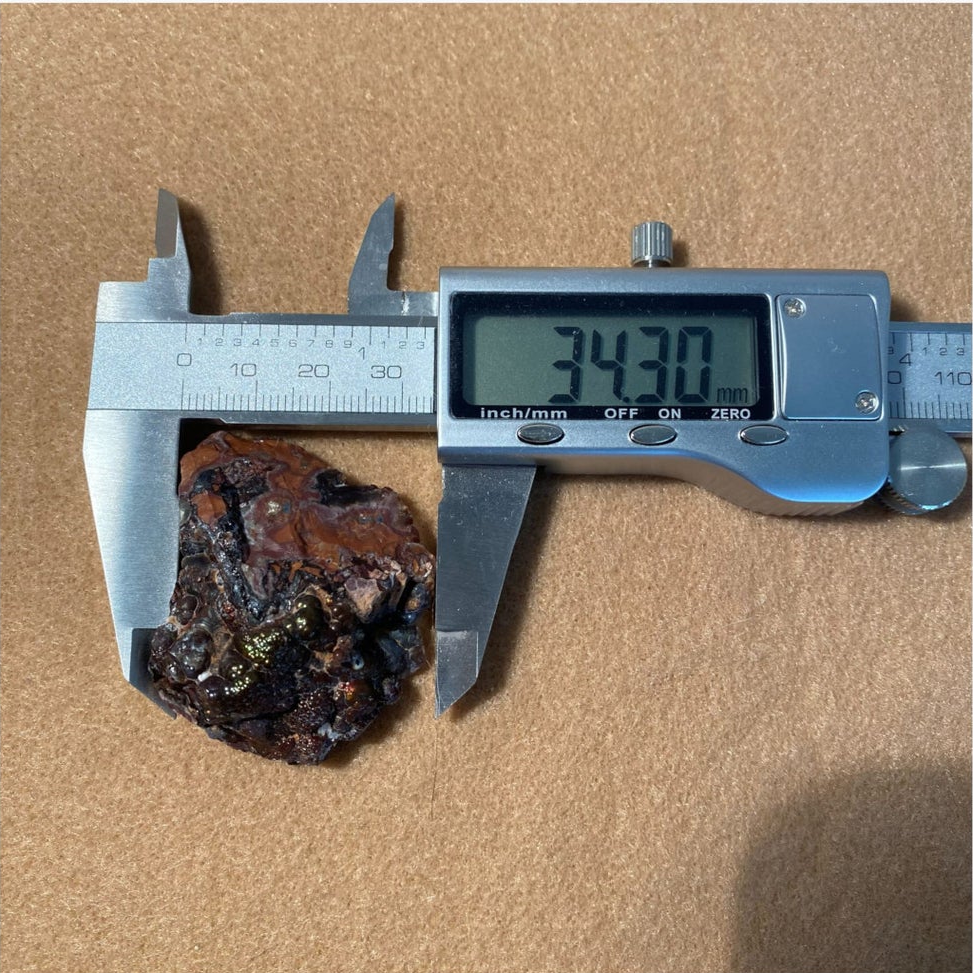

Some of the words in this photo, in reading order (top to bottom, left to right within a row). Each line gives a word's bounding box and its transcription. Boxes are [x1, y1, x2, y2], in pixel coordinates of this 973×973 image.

[176, 352, 192, 367] 0
[229, 362, 257, 377] 10
[297, 363, 330, 378] 20
[370, 364, 403, 379] 30
[548, 326, 712, 404] 34.30
[934, 371, 972, 386] 110
[480, 407, 568, 420] inch/mm
[604, 408, 639, 419] OFF
[658, 408, 682, 419] ON
[711, 408, 751, 419] ZERO
